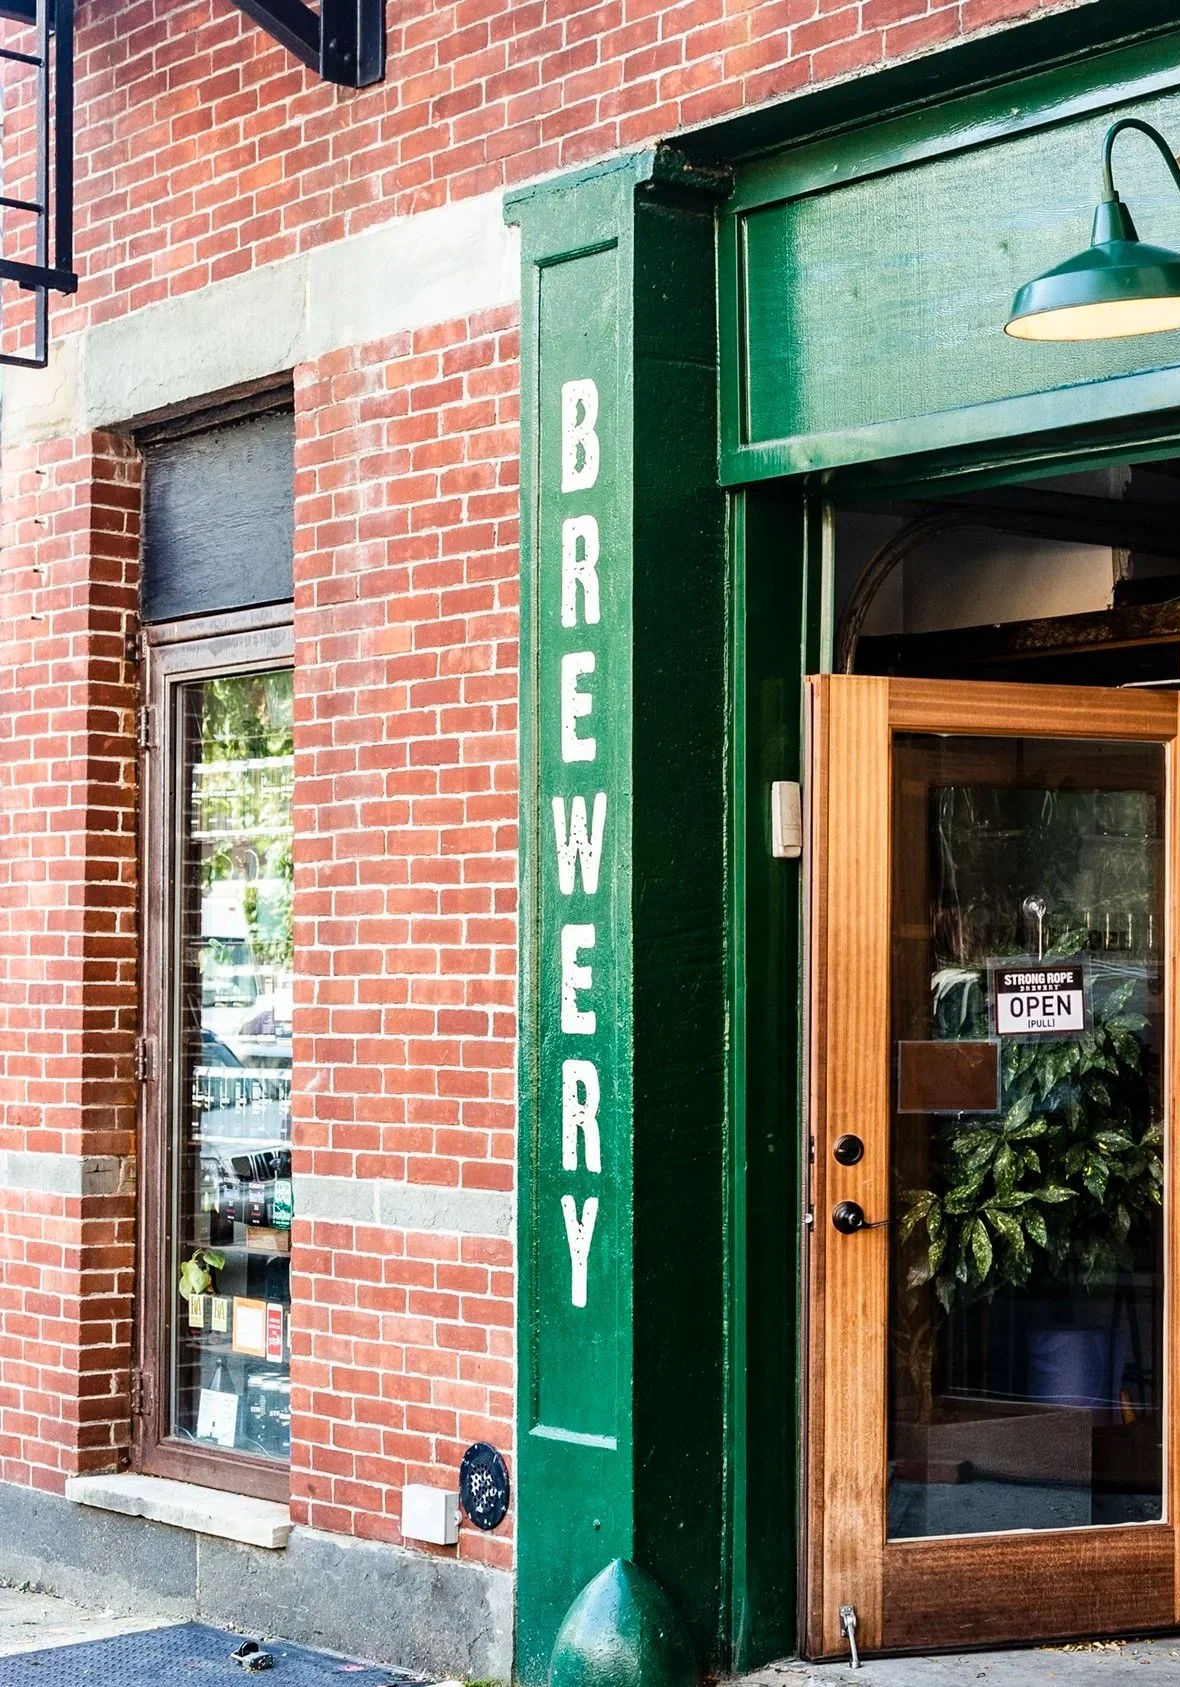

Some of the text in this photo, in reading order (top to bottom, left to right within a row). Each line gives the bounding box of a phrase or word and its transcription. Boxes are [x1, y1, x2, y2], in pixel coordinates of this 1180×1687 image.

[551, 378, 608, 1309] BREWERY
[1004, 971, 1074, 986] STRONG ROPE
[1019, 984, 1061, 992] BREWERY
[1010, 994, 1072, 1018] OPEN
[1027, 1018, 1056, 1029] (PULL)
